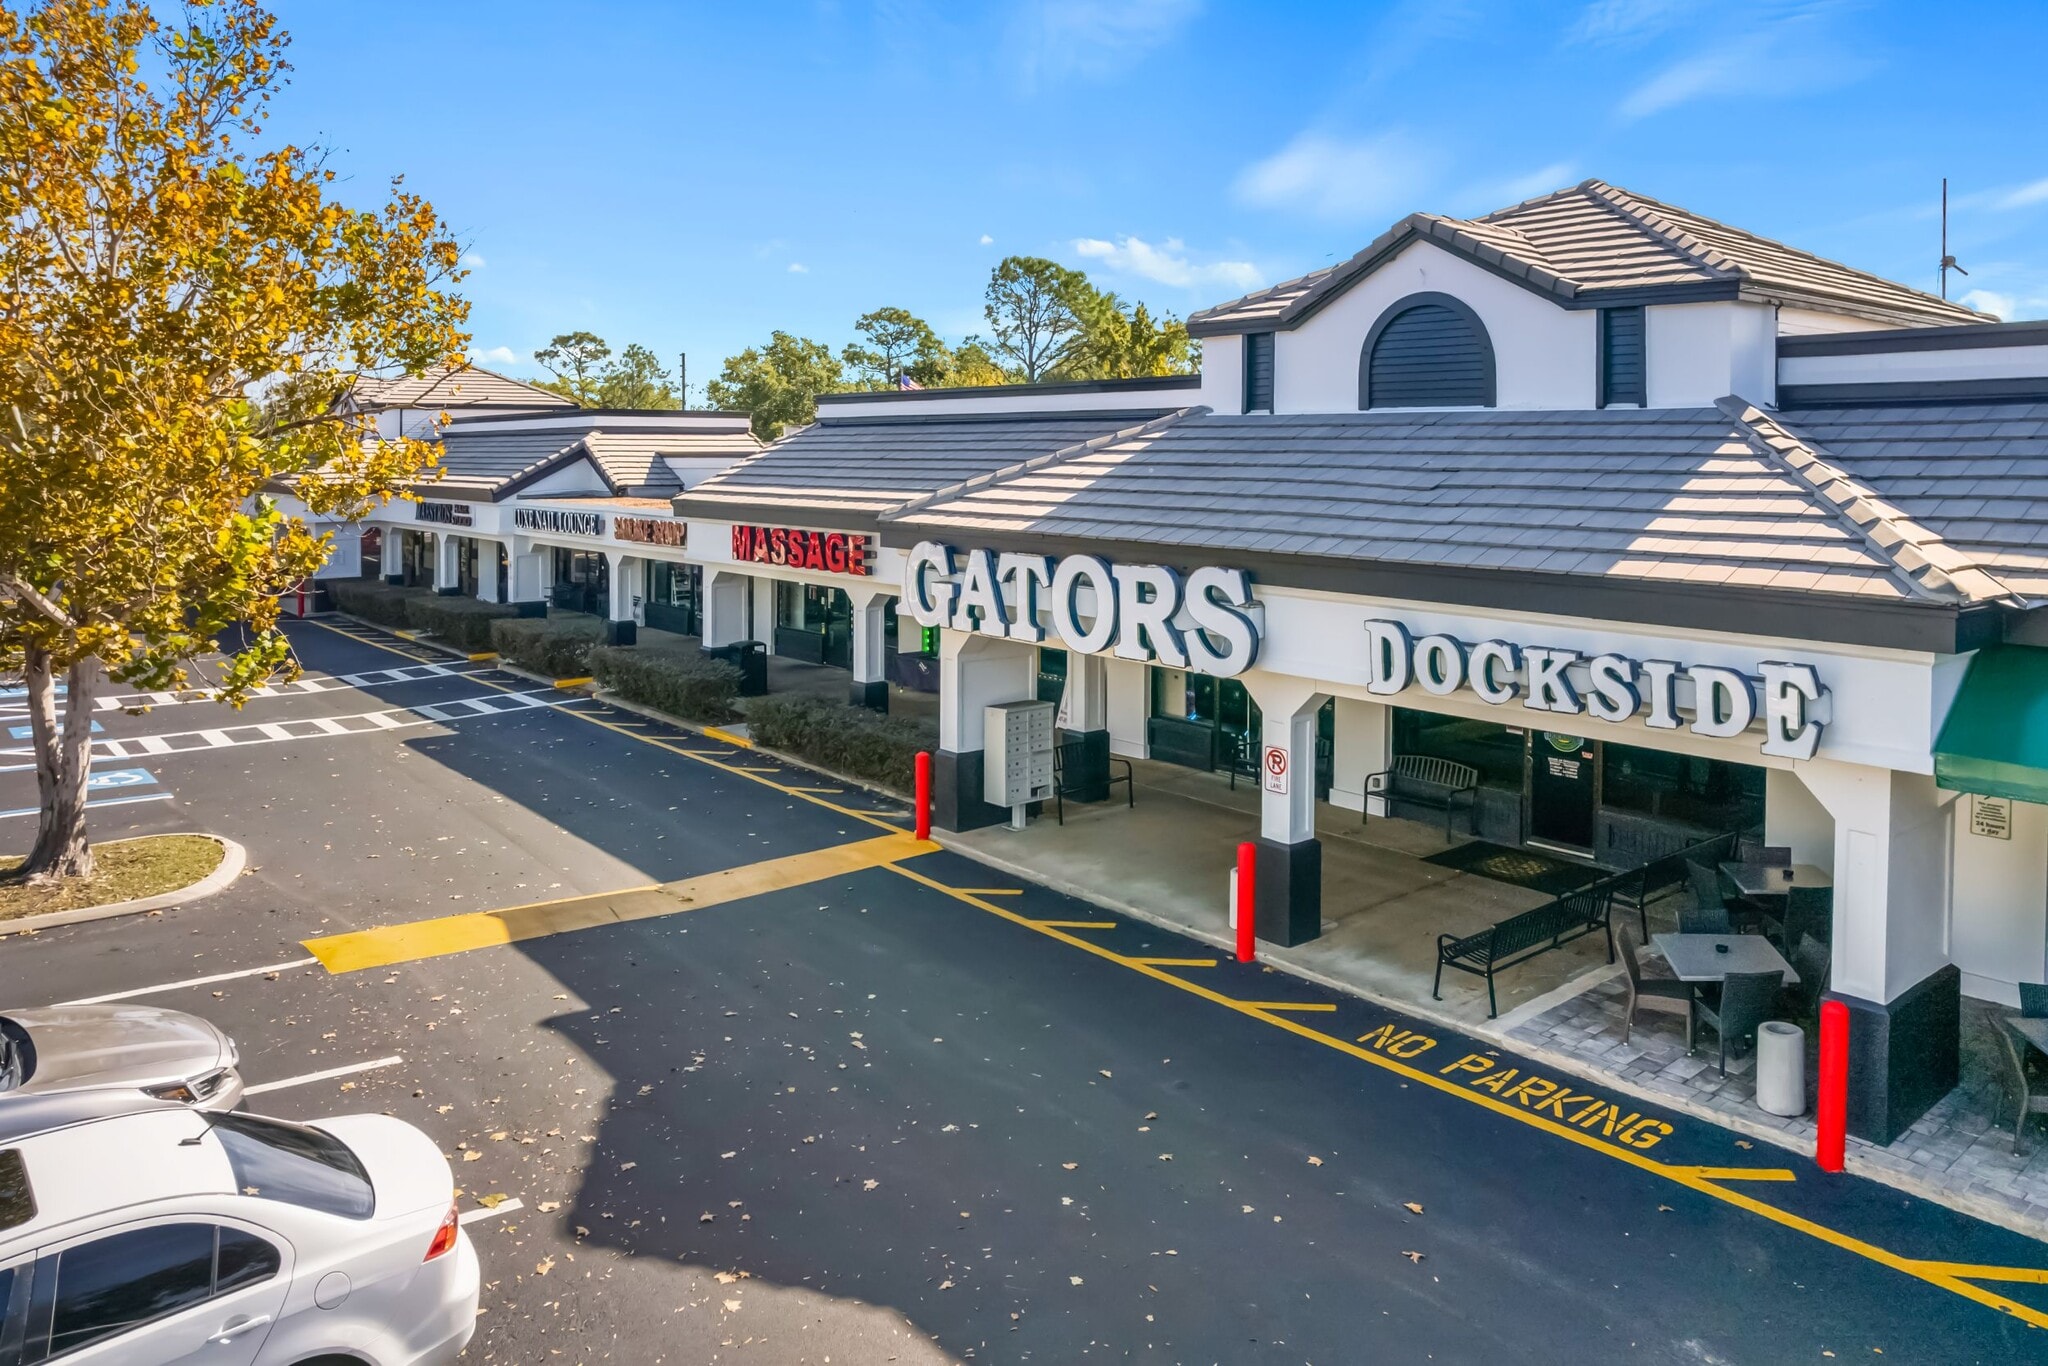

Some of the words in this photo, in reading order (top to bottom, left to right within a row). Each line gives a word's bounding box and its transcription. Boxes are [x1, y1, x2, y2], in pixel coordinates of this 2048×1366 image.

[513, 508, 535, 529] LUXE
[535, 509, 557, 532] NAIL
[558, 512, 600, 536] LOUNGE
[732, 525, 874, 576] MASSAGE
[905, 541, 1260, 677] GATORS
[1364, 618, 1825, 760] DOCKSIDE
[1271, 775, 1281, 783] FIRE
[1986, 822, 2005, 830] hours
[1357, 1023, 1437, 1058] NO
[1439, 1053, 1674, 1149] PARKING
